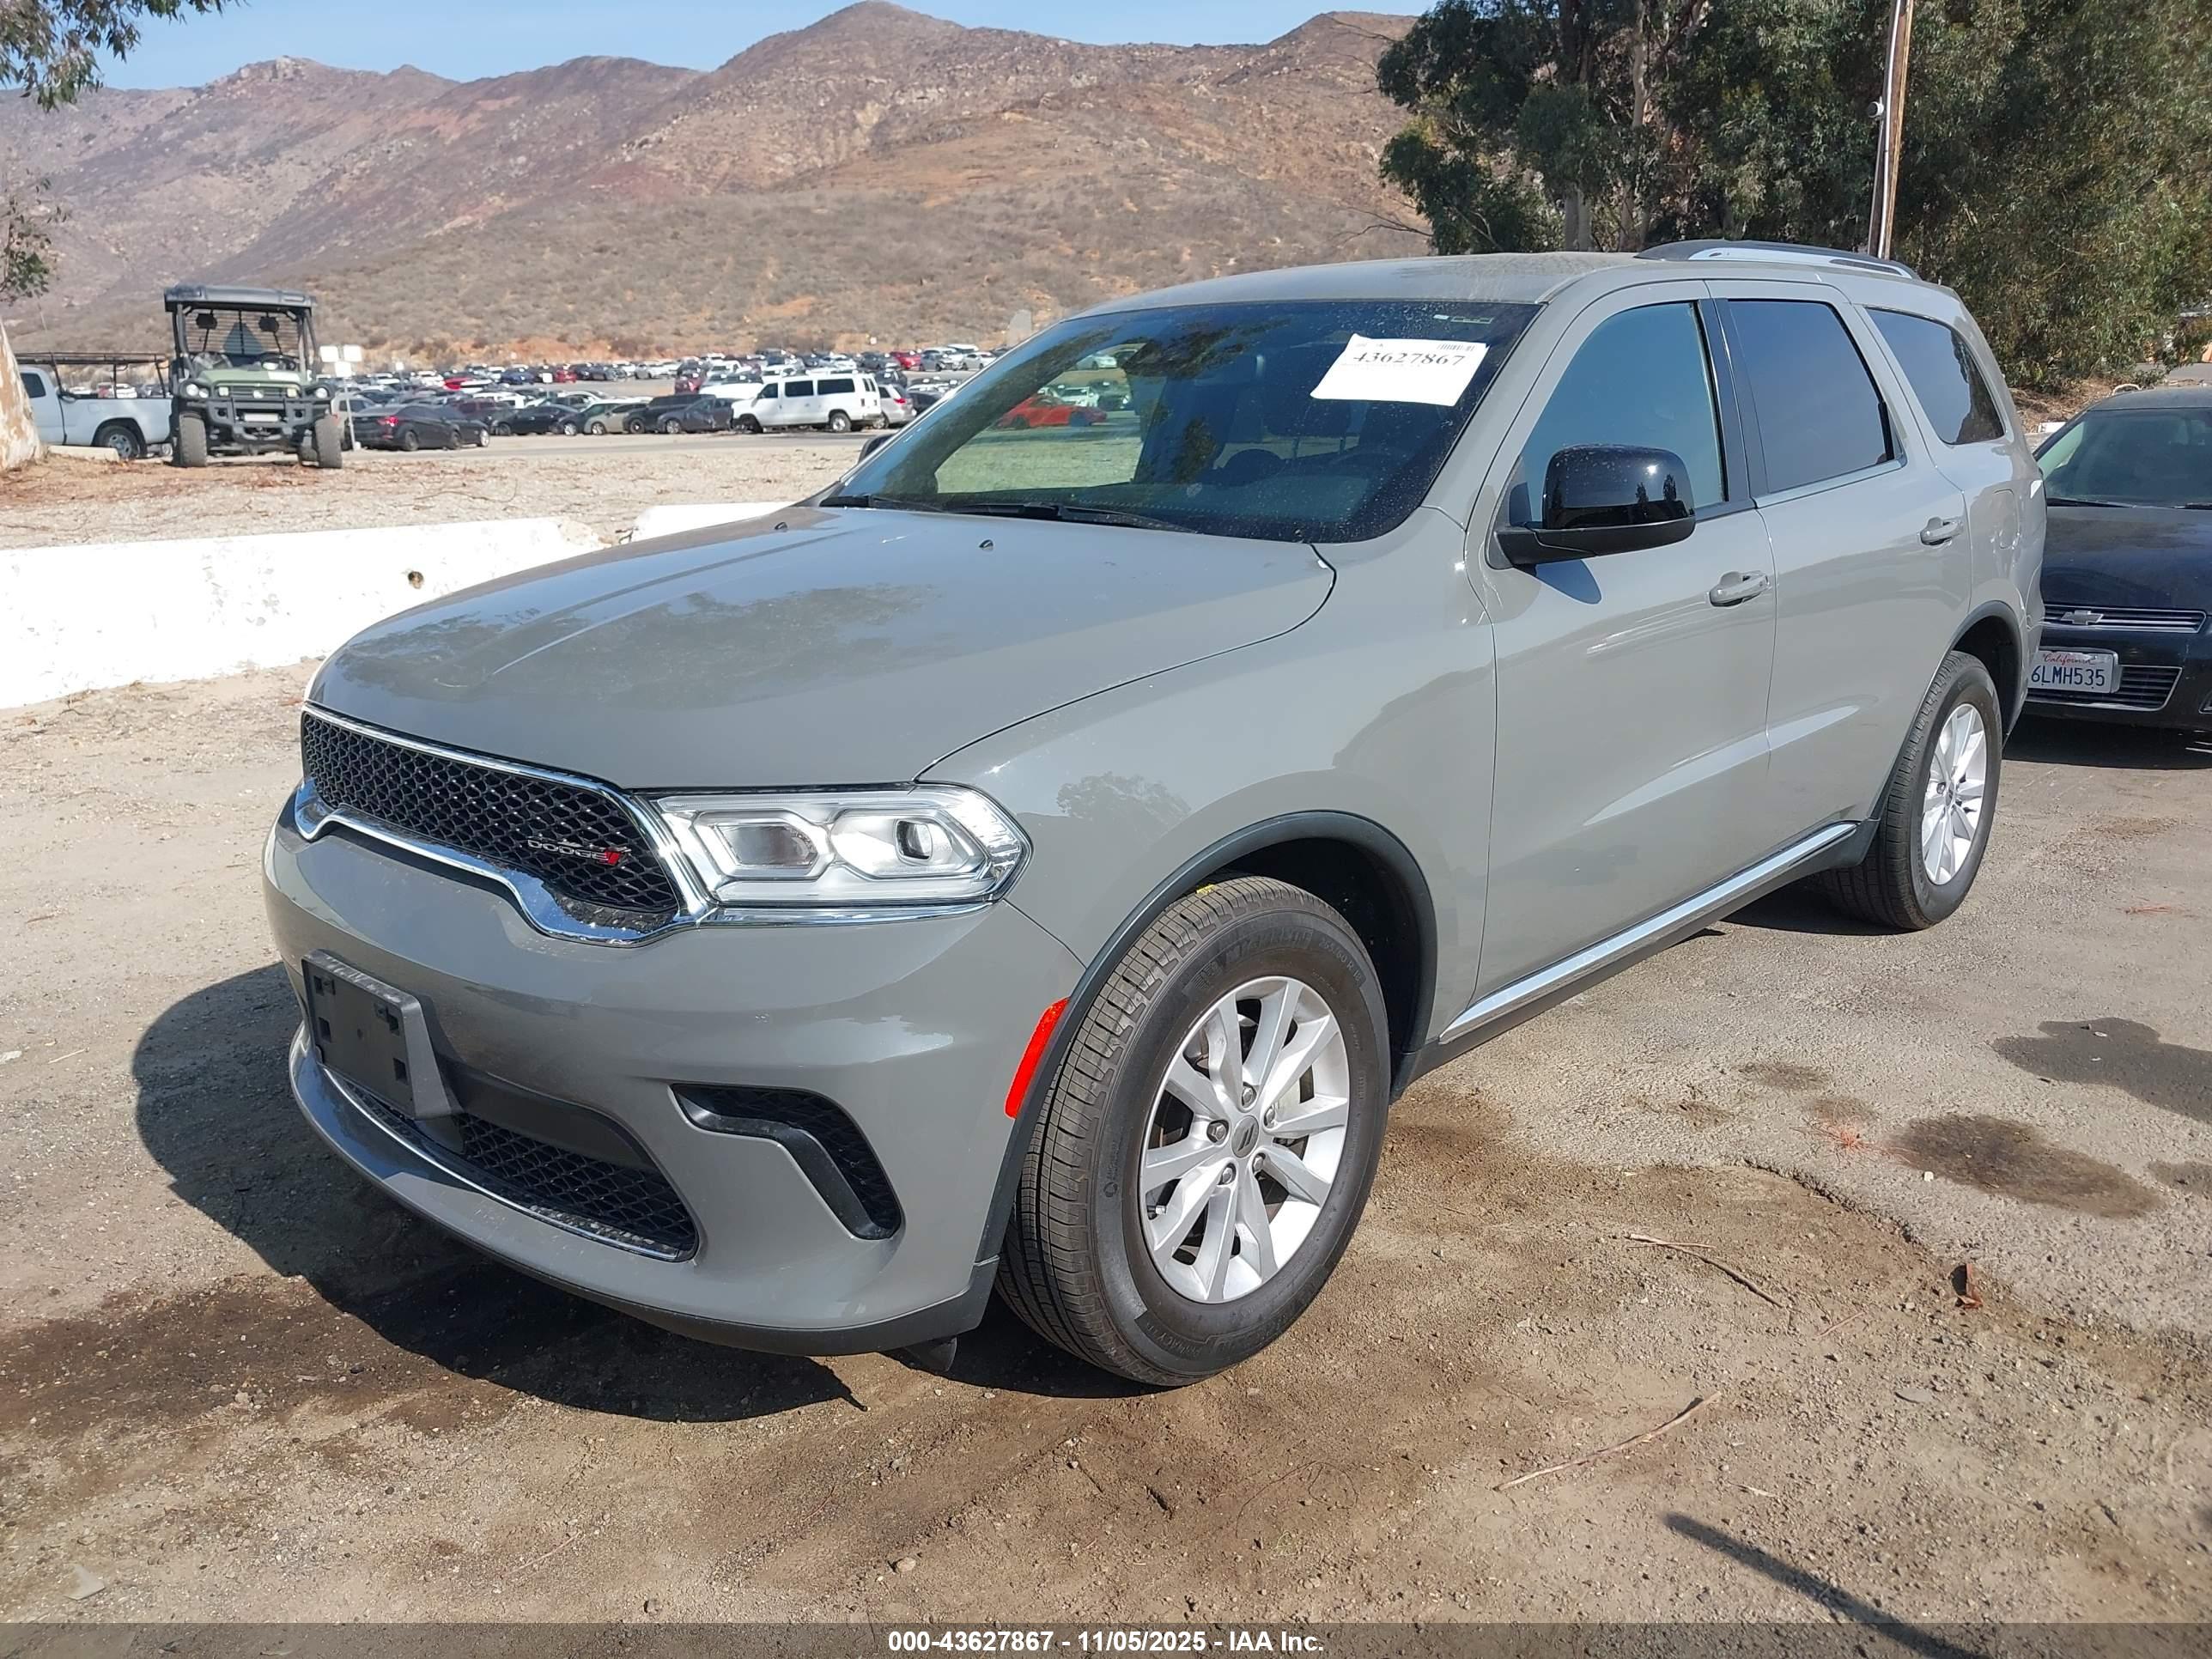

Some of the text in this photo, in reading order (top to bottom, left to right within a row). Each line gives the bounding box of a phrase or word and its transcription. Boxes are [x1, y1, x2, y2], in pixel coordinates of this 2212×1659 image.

[1352, 351, 1466, 366] 43627867
[2044, 653, 2096, 665] California
[2031, 665, 2106, 687] 6LMH535
[527, 838, 609, 861] DODGE
